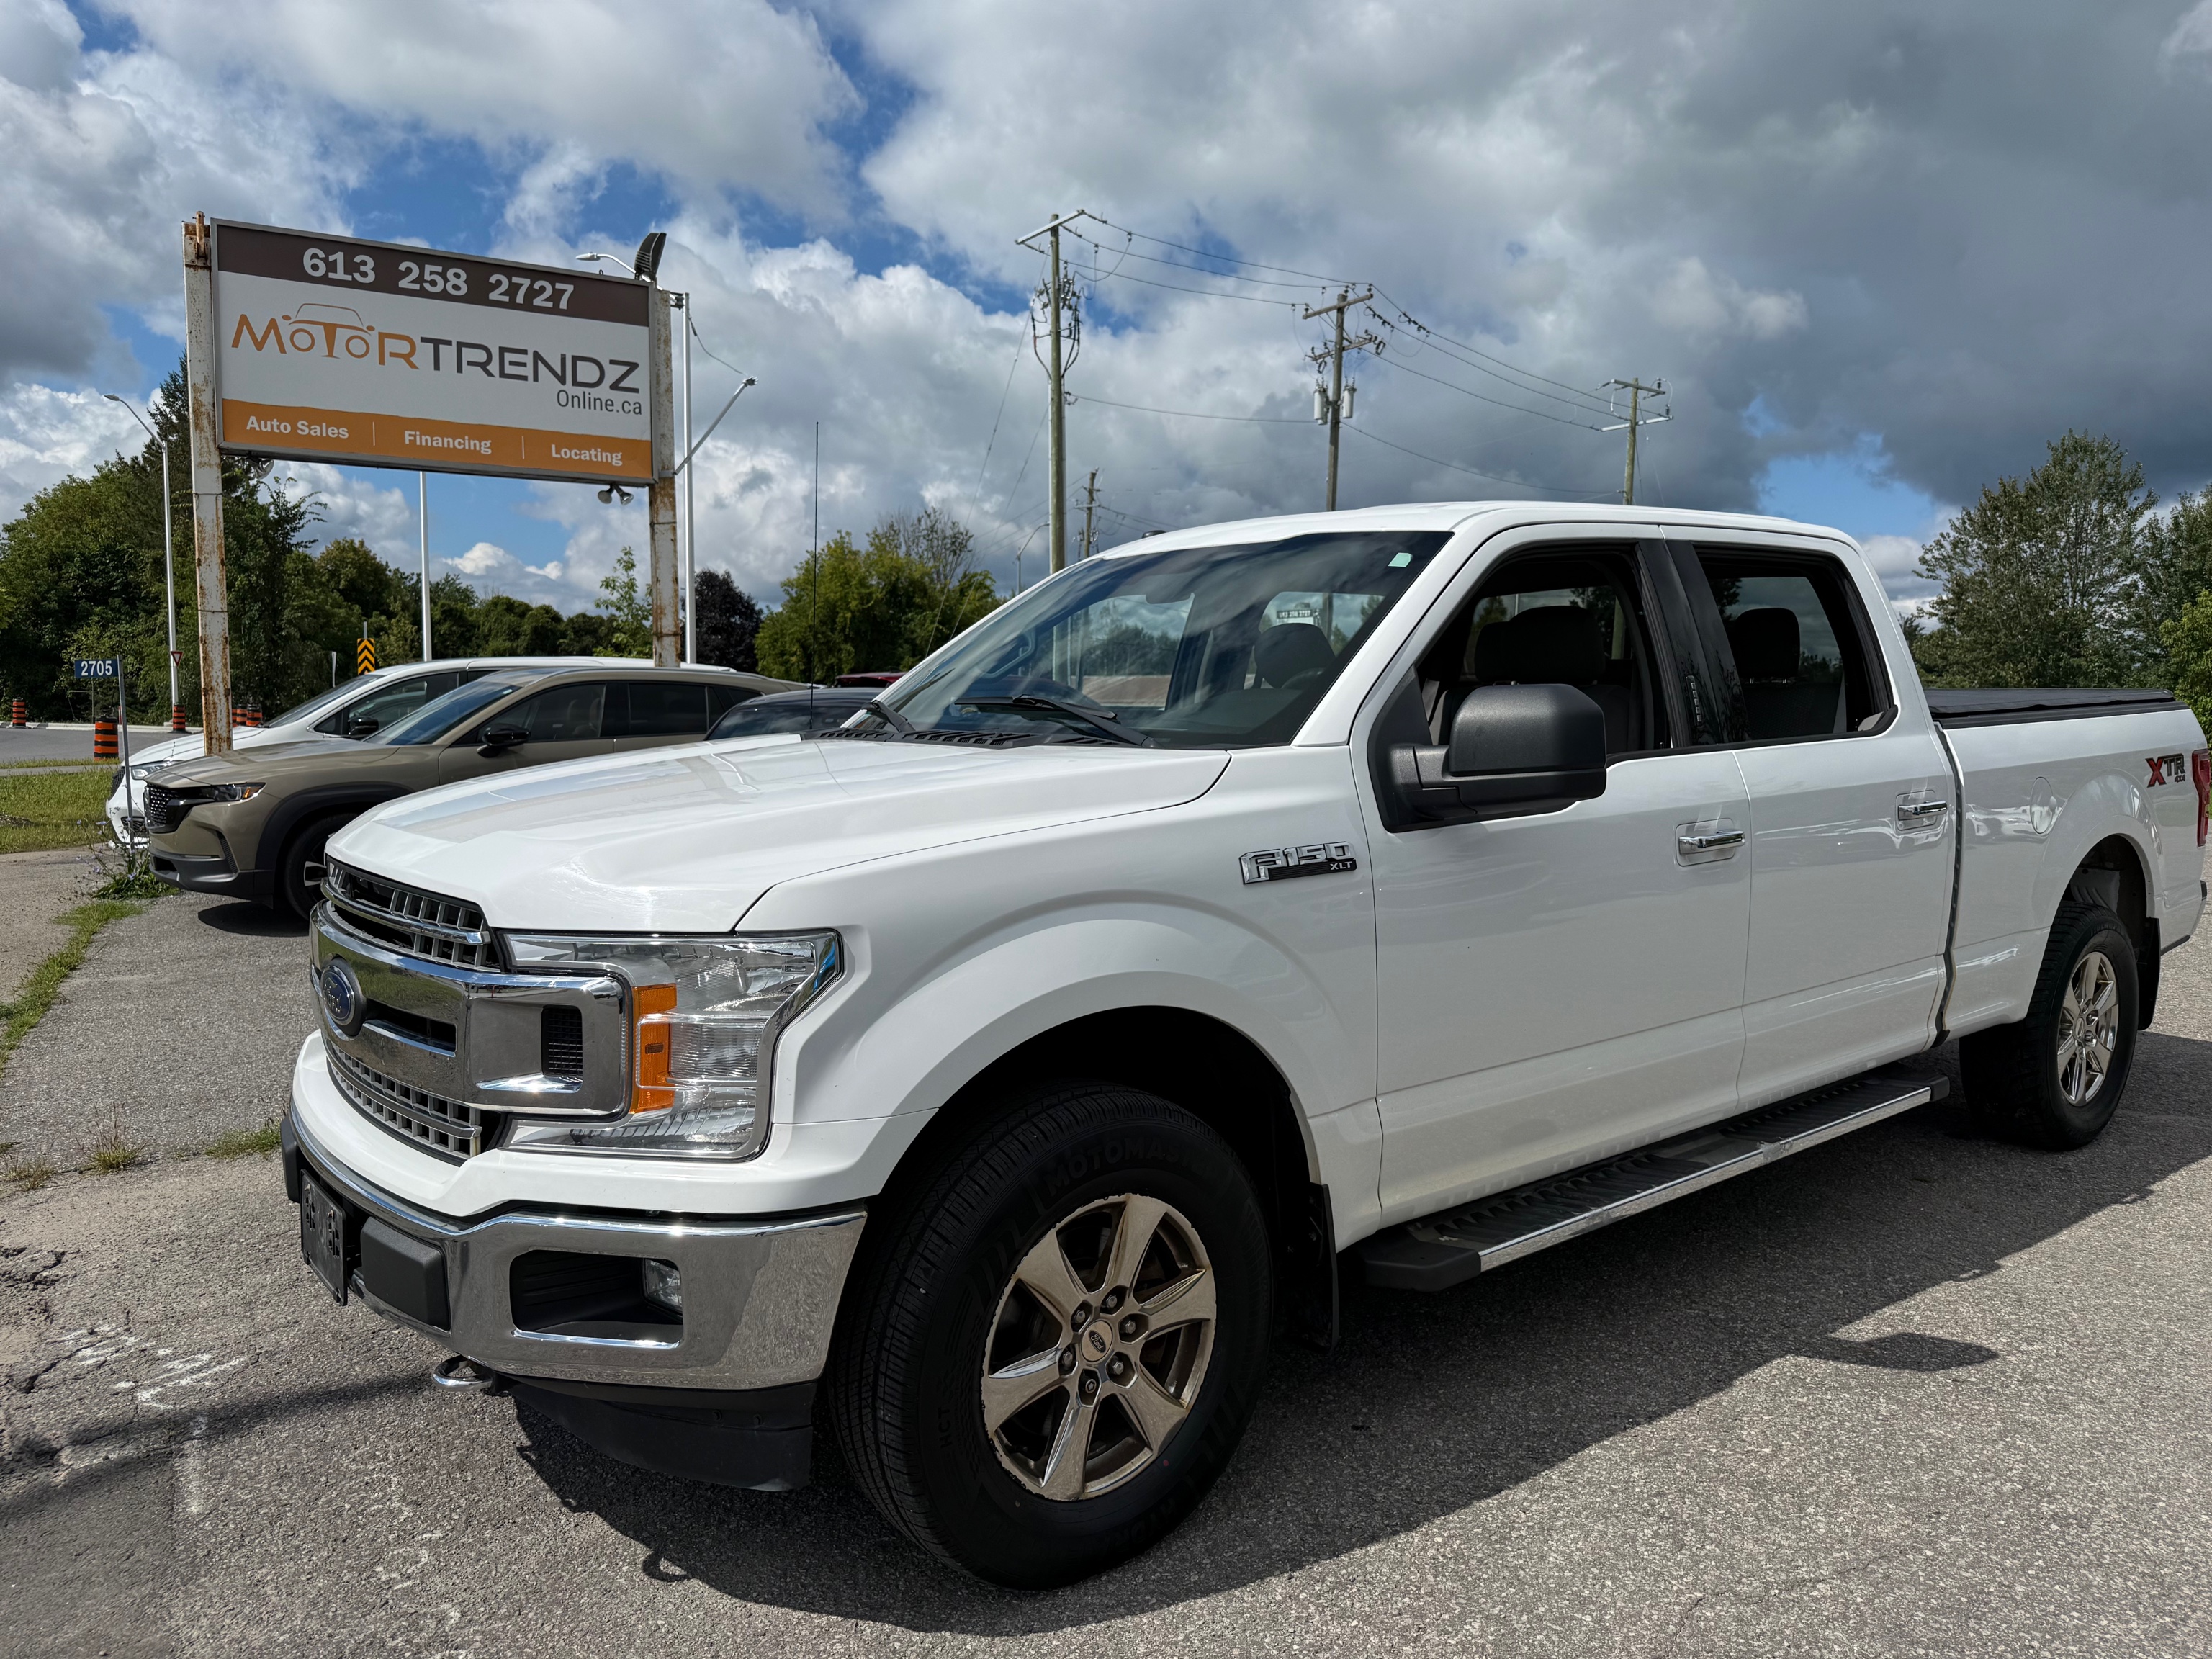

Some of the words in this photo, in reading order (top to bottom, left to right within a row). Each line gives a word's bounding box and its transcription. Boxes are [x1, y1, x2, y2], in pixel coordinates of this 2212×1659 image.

[302, 248, 375, 283] 613
[398, 261, 468, 296] 258
[488, 274, 574, 310] 2727
[556, 390, 642, 415] Online.ca
[246, 415, 291, 433] Auto
[297, 420, 349, 439] Sales
[405, 431, 492, 454] Financing
[552, 444, 622, 466] Locating
[81, 660, 112, 676] 2705
[2145, 753, 2186, 788] XTR
[1330, 861, 1352, 871] XLT
[1090, 1334, 1104, 1351] Ford
